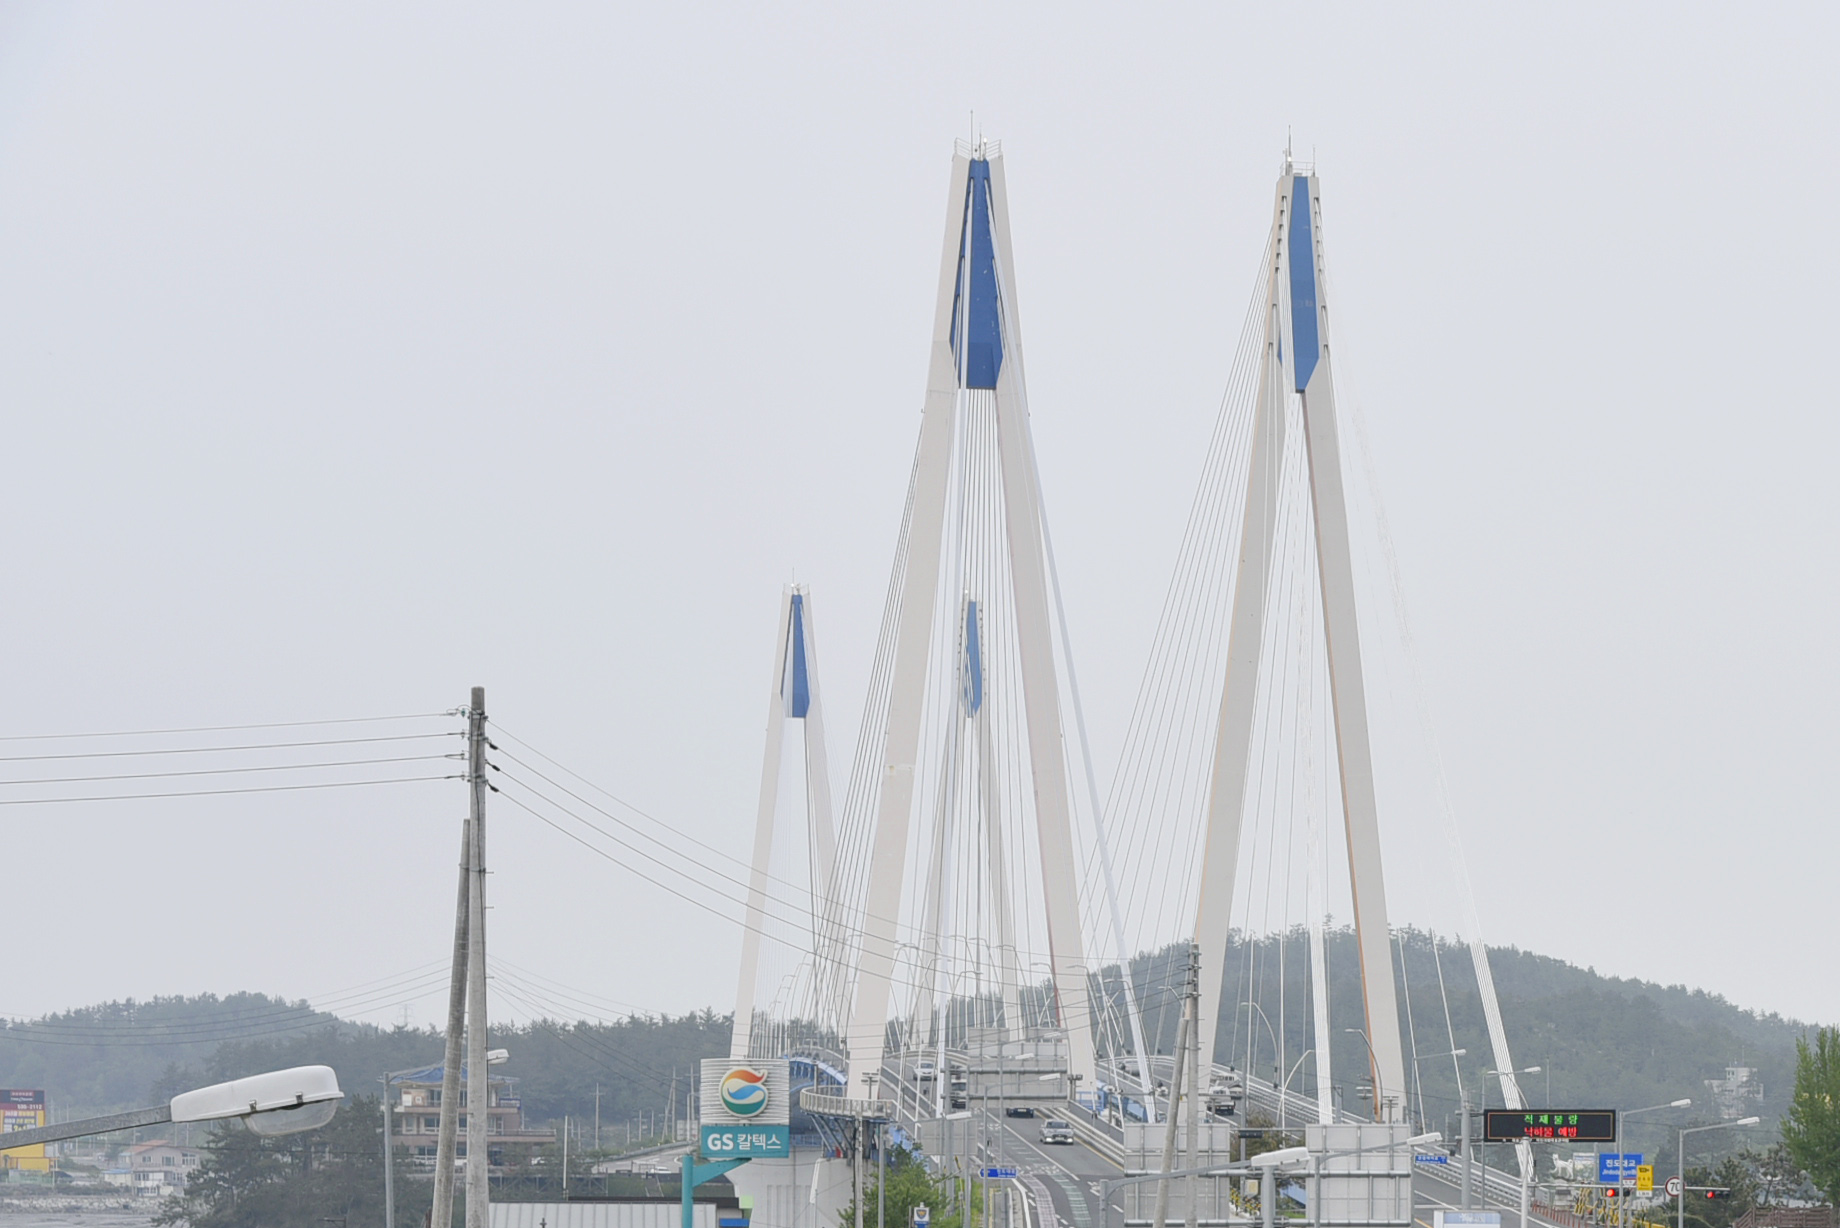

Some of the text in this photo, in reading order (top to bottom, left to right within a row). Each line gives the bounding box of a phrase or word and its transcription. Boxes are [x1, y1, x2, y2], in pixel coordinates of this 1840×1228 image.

[707, 1133, 782, 1150] GS 칼텍스
[1670, 1182, 1680, 1192] 70
